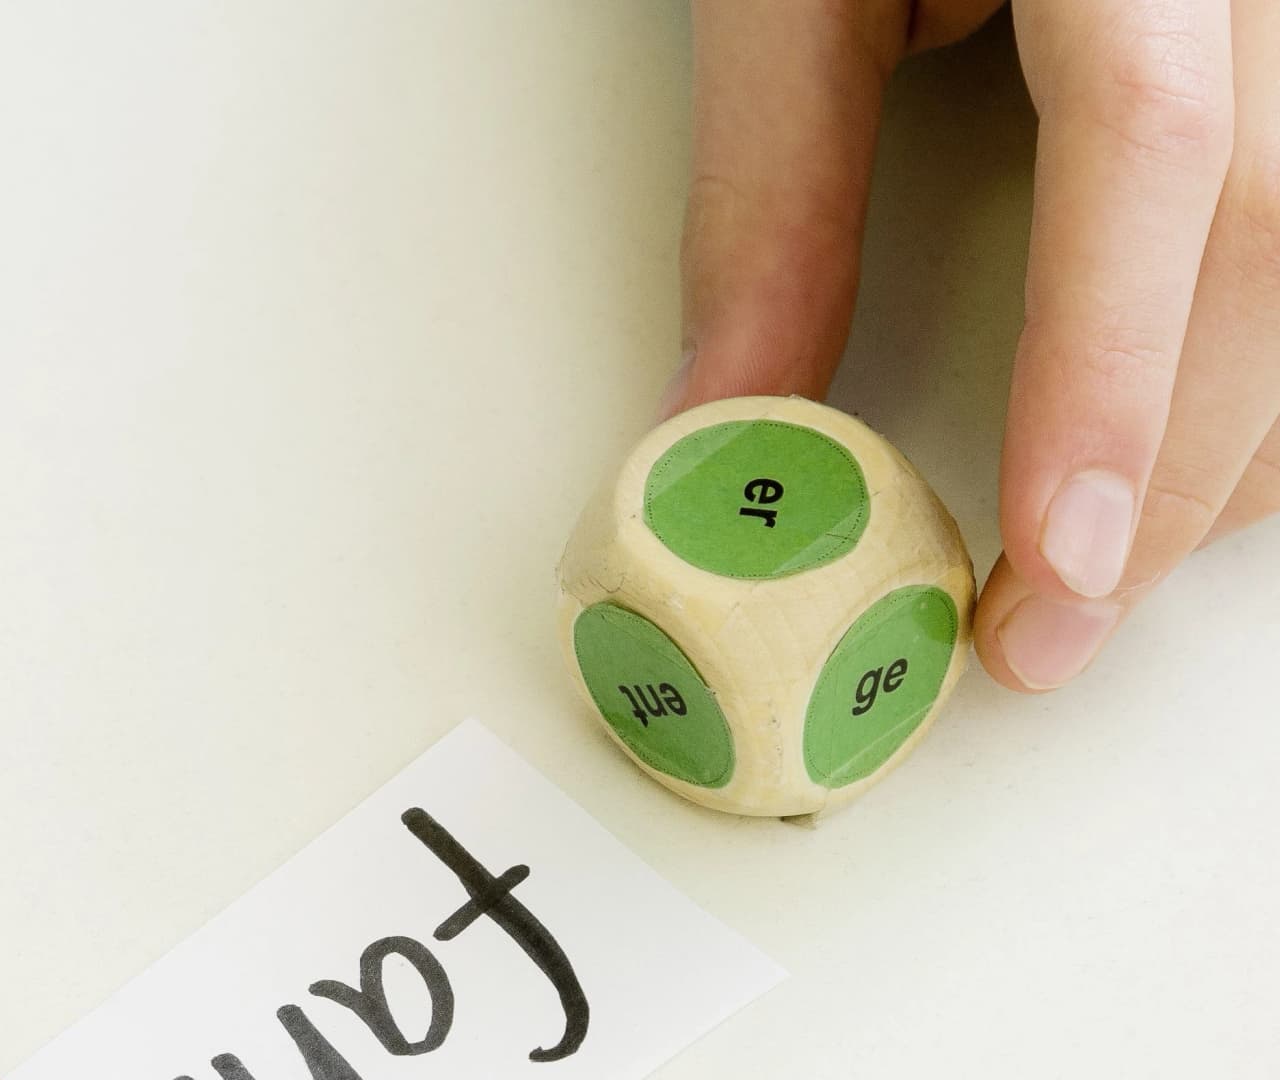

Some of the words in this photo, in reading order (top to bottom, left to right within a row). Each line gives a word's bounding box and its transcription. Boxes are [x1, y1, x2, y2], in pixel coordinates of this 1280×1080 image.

[739, 478, 784, 528] er
[619, 682, 688, 727] ent
[852, 658, 908, 716] ge
